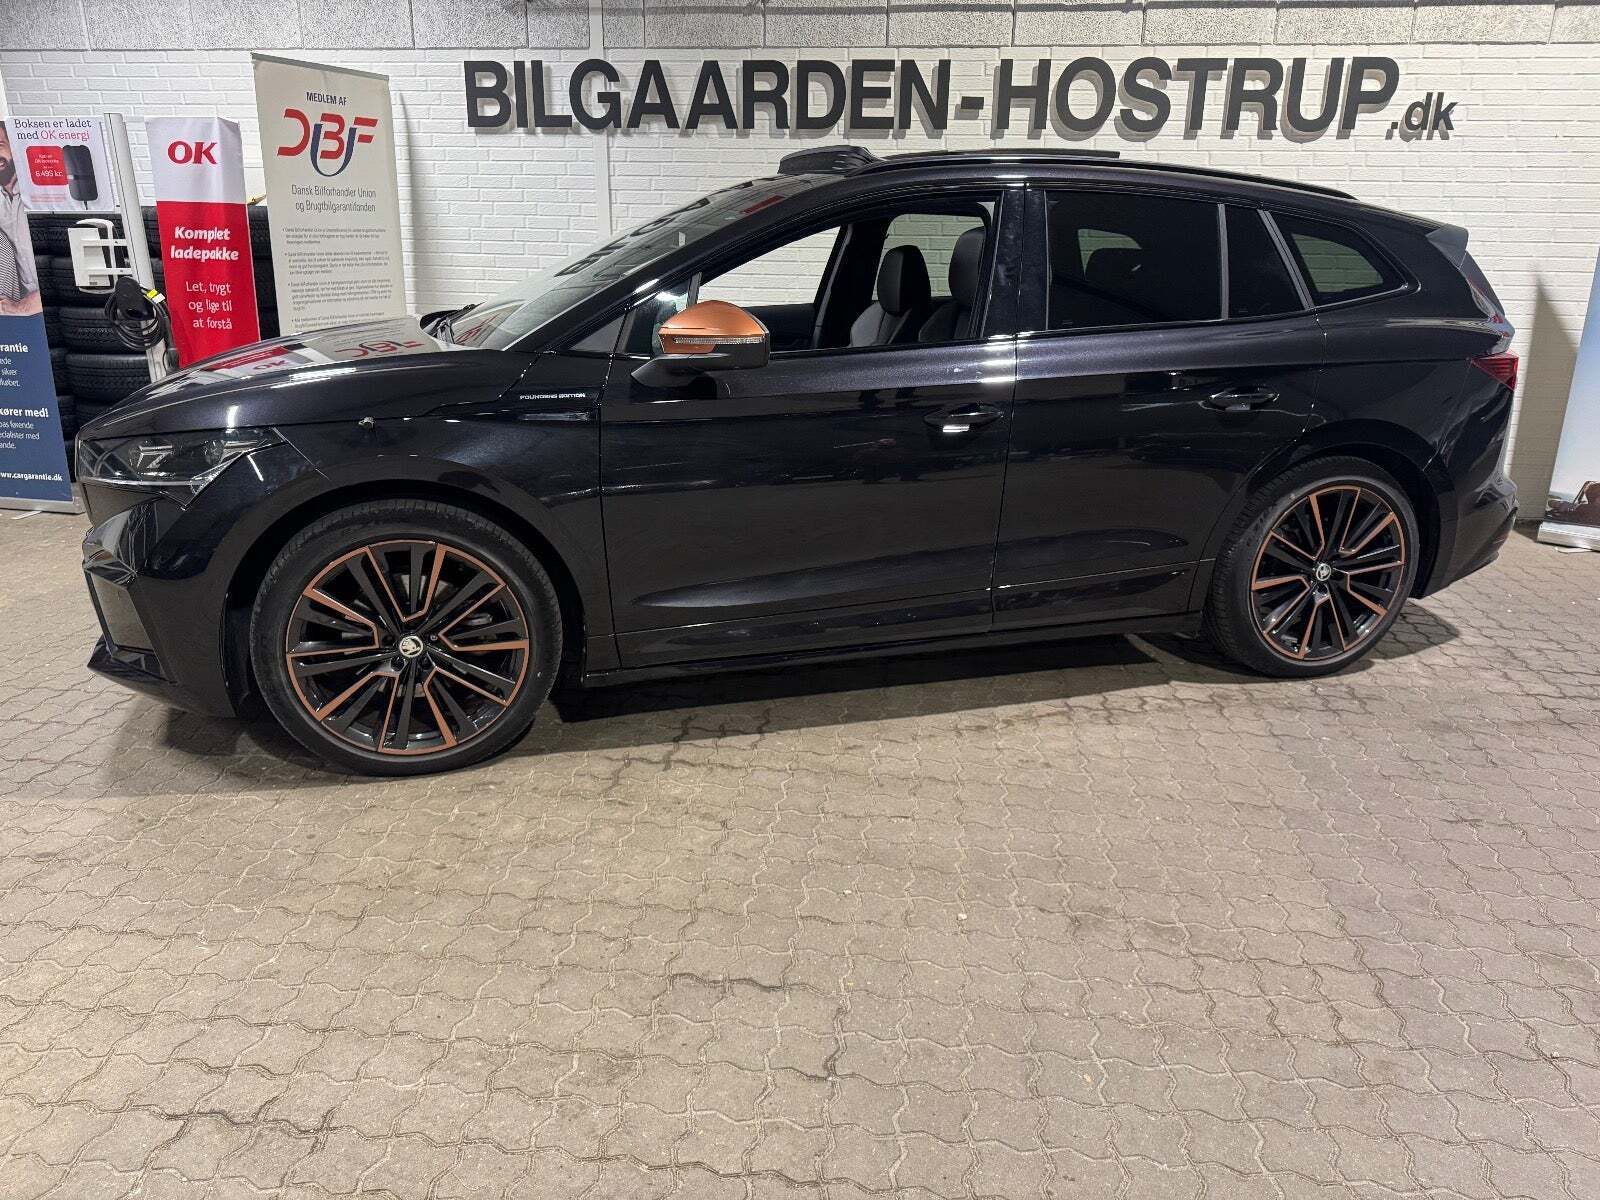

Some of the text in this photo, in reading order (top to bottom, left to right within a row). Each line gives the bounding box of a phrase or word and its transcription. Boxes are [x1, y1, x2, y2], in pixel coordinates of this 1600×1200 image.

[306, 91, 347, 106] MEDLEM AF
[14, 118, 51, 129] Boksen
[66, 118, 92, 128] ladet
[17, 130, 90, 142] med OK energi
[167, 140, 218, 165] OK
[291, 184, 377, 198] Dansk Bilforhandler Union
[295, 200, 376, 213] og Brugtbilgarantifonden
[174, 226, 231, 243] Komplet
[170, 245, 239, 262] ladepakke
[185, 281, 231, 296] Let, trygt
[188, 299, 233, 313] og lige til
[193, 317, 233, 330] at forstå
[25, 407, 49, 418] med!
[25, 432, 40, 440] med
